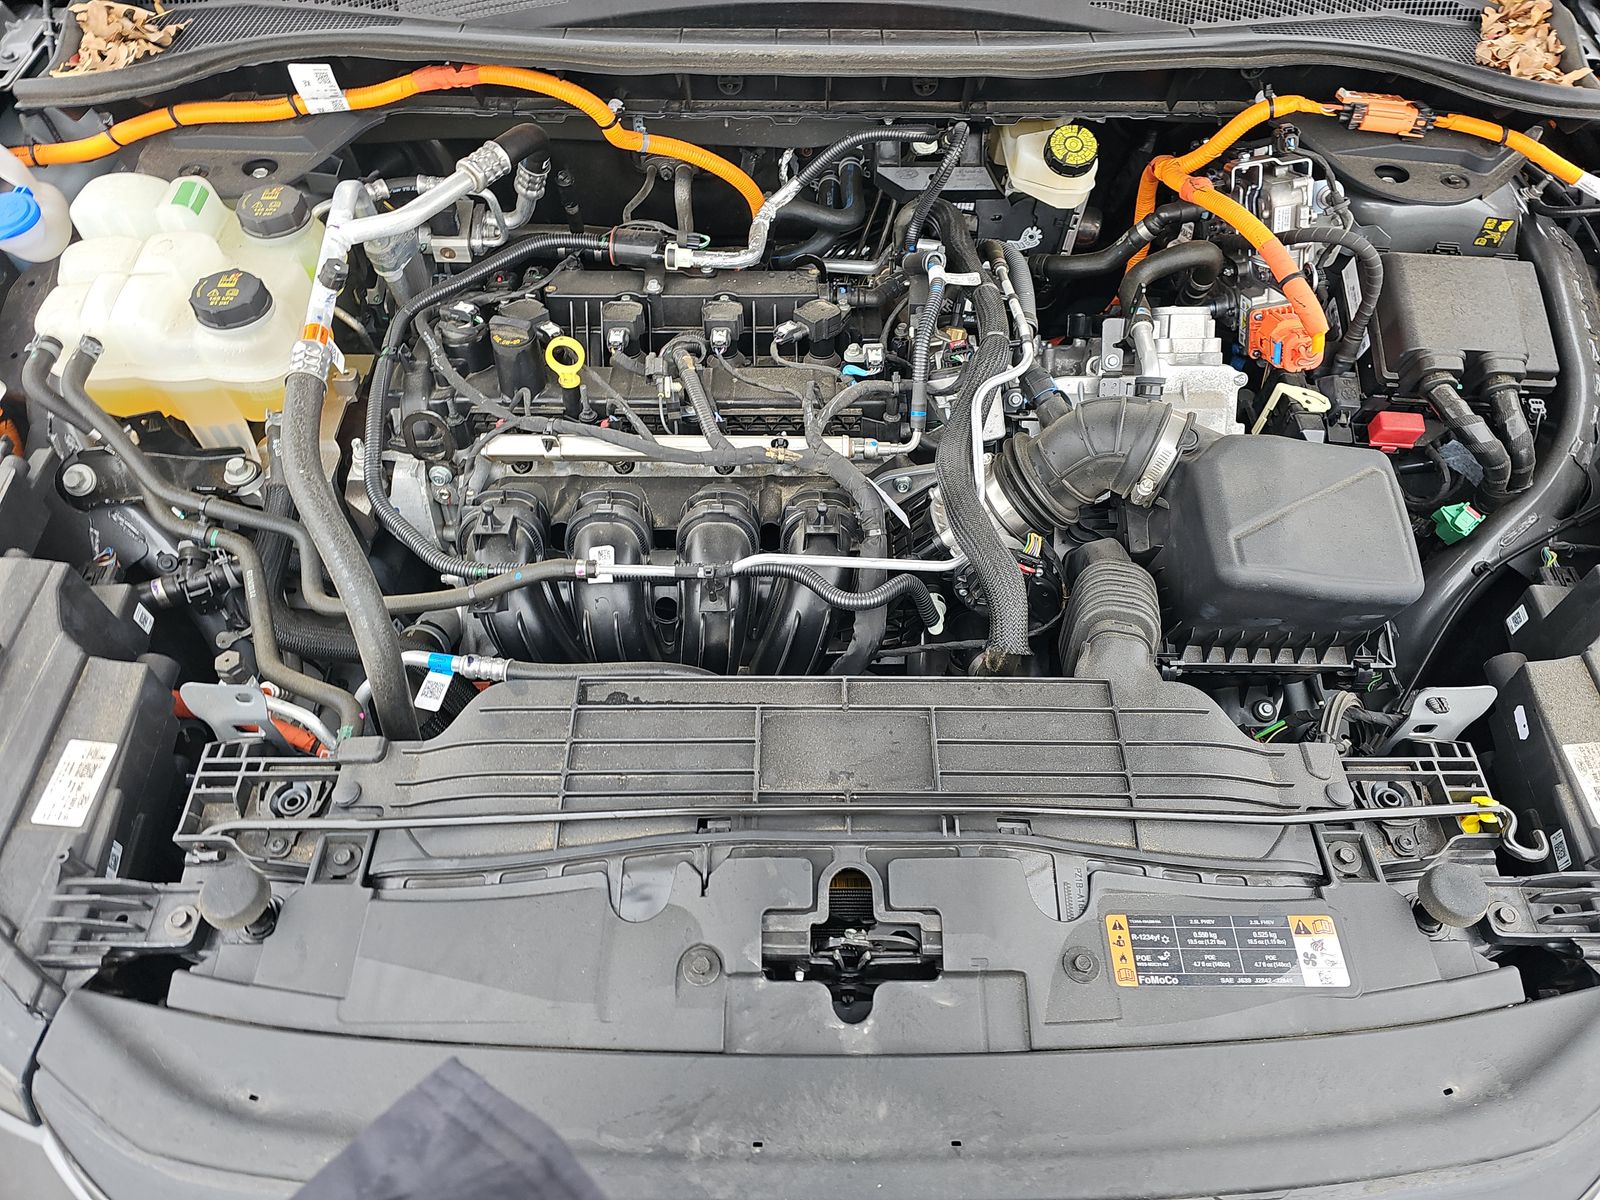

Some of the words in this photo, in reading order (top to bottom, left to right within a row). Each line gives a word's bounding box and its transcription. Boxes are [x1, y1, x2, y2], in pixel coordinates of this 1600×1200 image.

[1131, 934, 1160, 942] R-1234yf
[1209, 932, 1218, 940] kg
[1269, 932, 1278, 940] kg
[1138, 976, 1179, 984] FoMoCo
